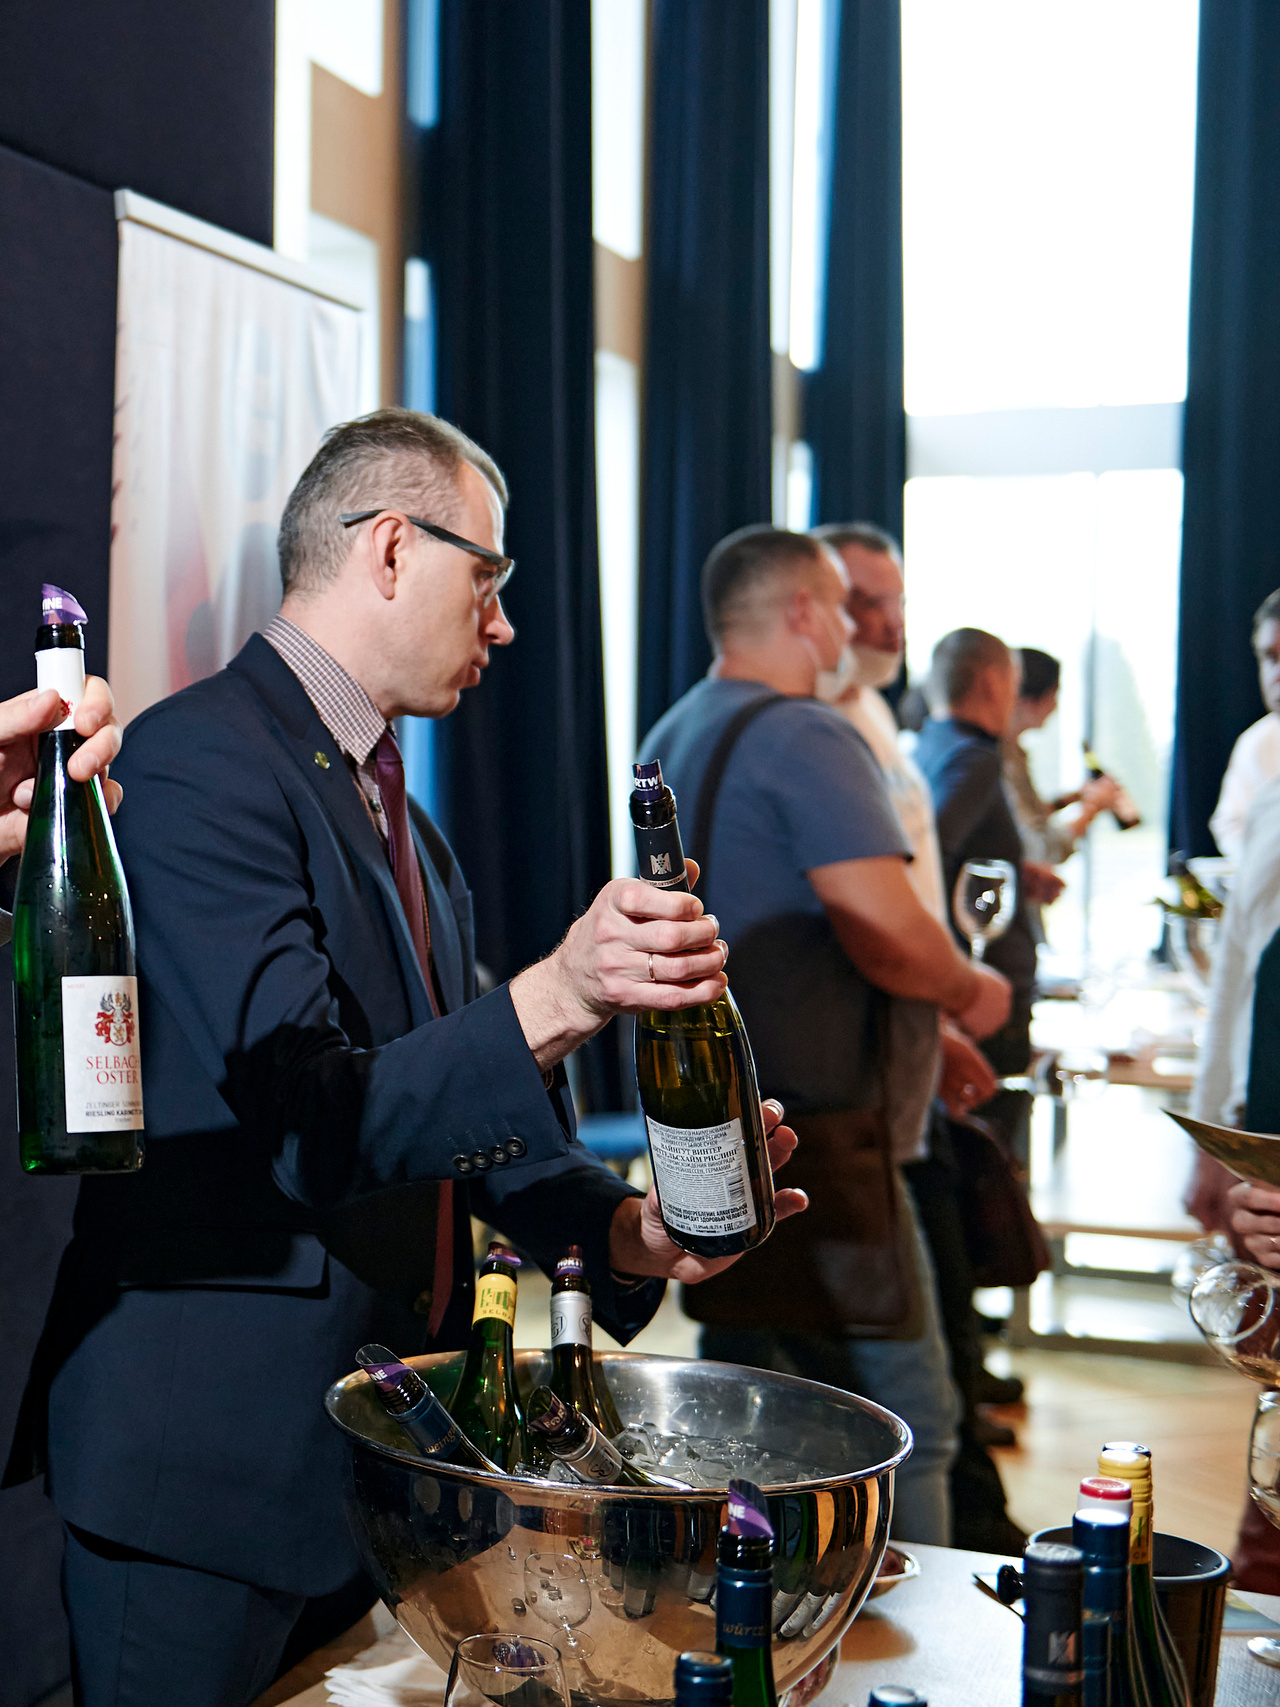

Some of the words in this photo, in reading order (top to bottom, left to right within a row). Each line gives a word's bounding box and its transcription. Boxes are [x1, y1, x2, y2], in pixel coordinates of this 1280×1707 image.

[96, 1069, 139, 1085] OSTER
[691, 1124, 731, 1136] НАИМЕНОВАНИЯ
[661, 1143, 691, 1154] ВАЙНГУТ
[692, 1146, 722, 1155] ВИНТЕР
[703, 1149, 737, 1162] РИСЛИНГ
[708, 1157, 735, 1167] ВИНОГРАДА
